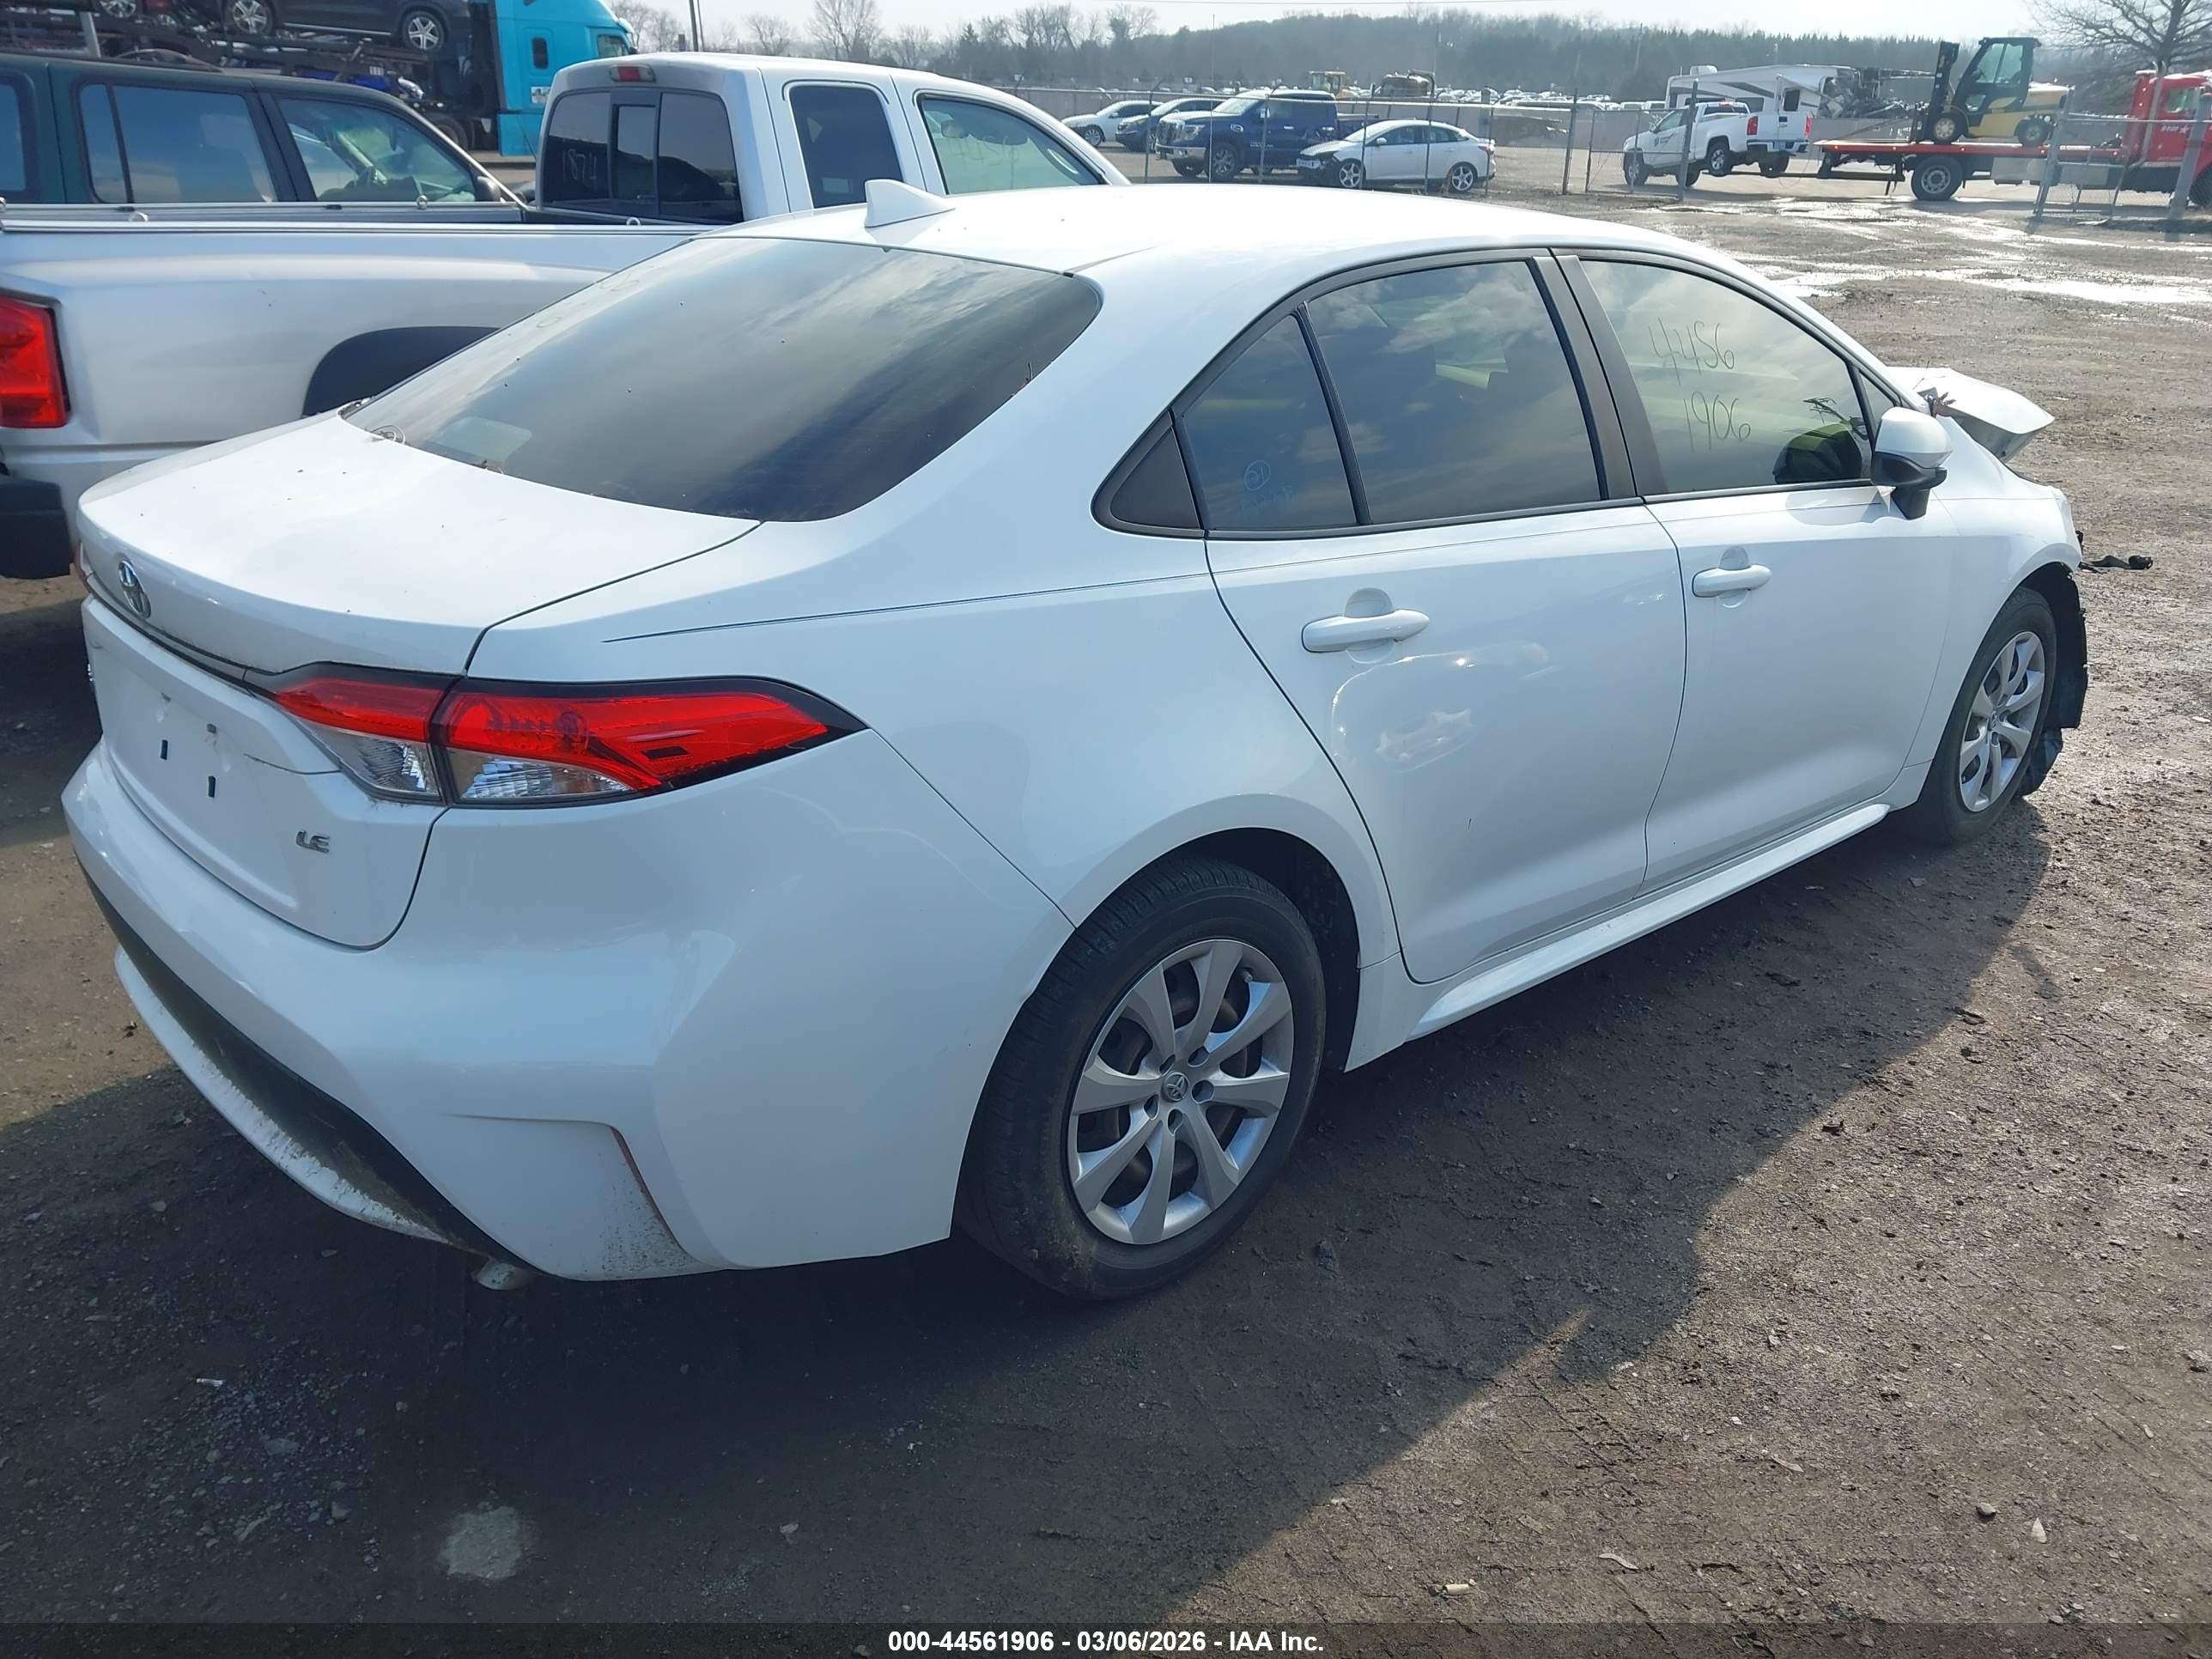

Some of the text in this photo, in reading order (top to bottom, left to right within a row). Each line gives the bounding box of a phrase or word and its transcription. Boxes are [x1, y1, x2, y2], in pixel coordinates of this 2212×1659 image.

[1648, 317, 1735, 386] 4456
[1683, 391, 1752, 453] 1906
[295, 830, 331, 854] LE
